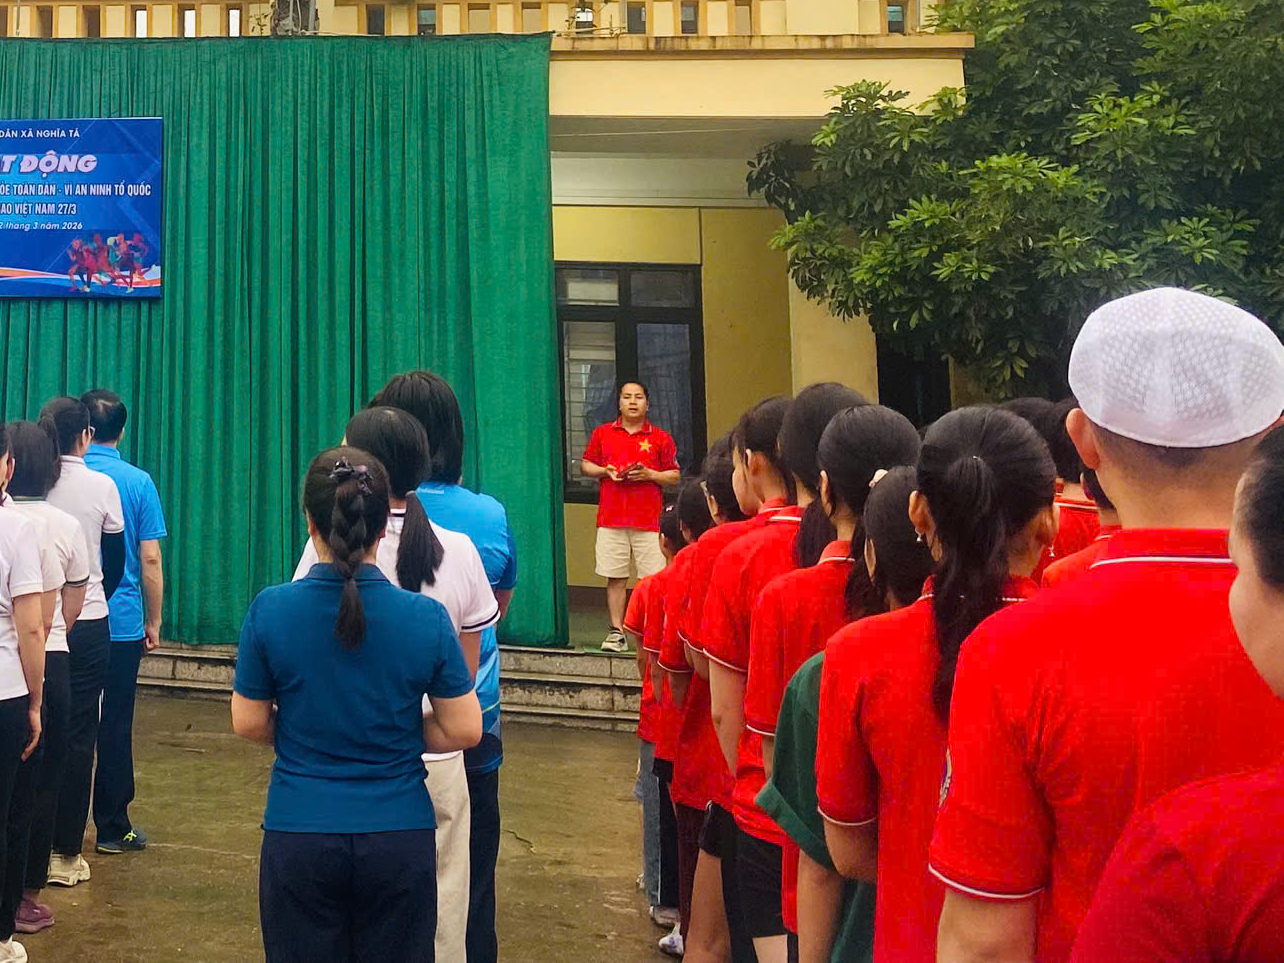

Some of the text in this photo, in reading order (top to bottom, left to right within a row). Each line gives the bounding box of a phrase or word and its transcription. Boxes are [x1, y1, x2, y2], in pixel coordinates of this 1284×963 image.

[20, 128, 34, 137] XÃ
[36, 127, 66, 137] NGHĨA
[69, 127, 80, 137] TÁ
[19, 149, 97, 177] ĐỘNG
[38, 182, 56, 195] DÂN
[75, 184, 87, 195] AN
[90, 184, 111, 195] NINH
[114, 180, 125, 195] TỔ
[127, 181, 151, 196] QUỐC
[14, 201, 33, 217] VIỆT
[35, 203, 56, 214] NAM
[57, 203, 77, 214] 27/3
[62, 221, 83, 230] 2026
